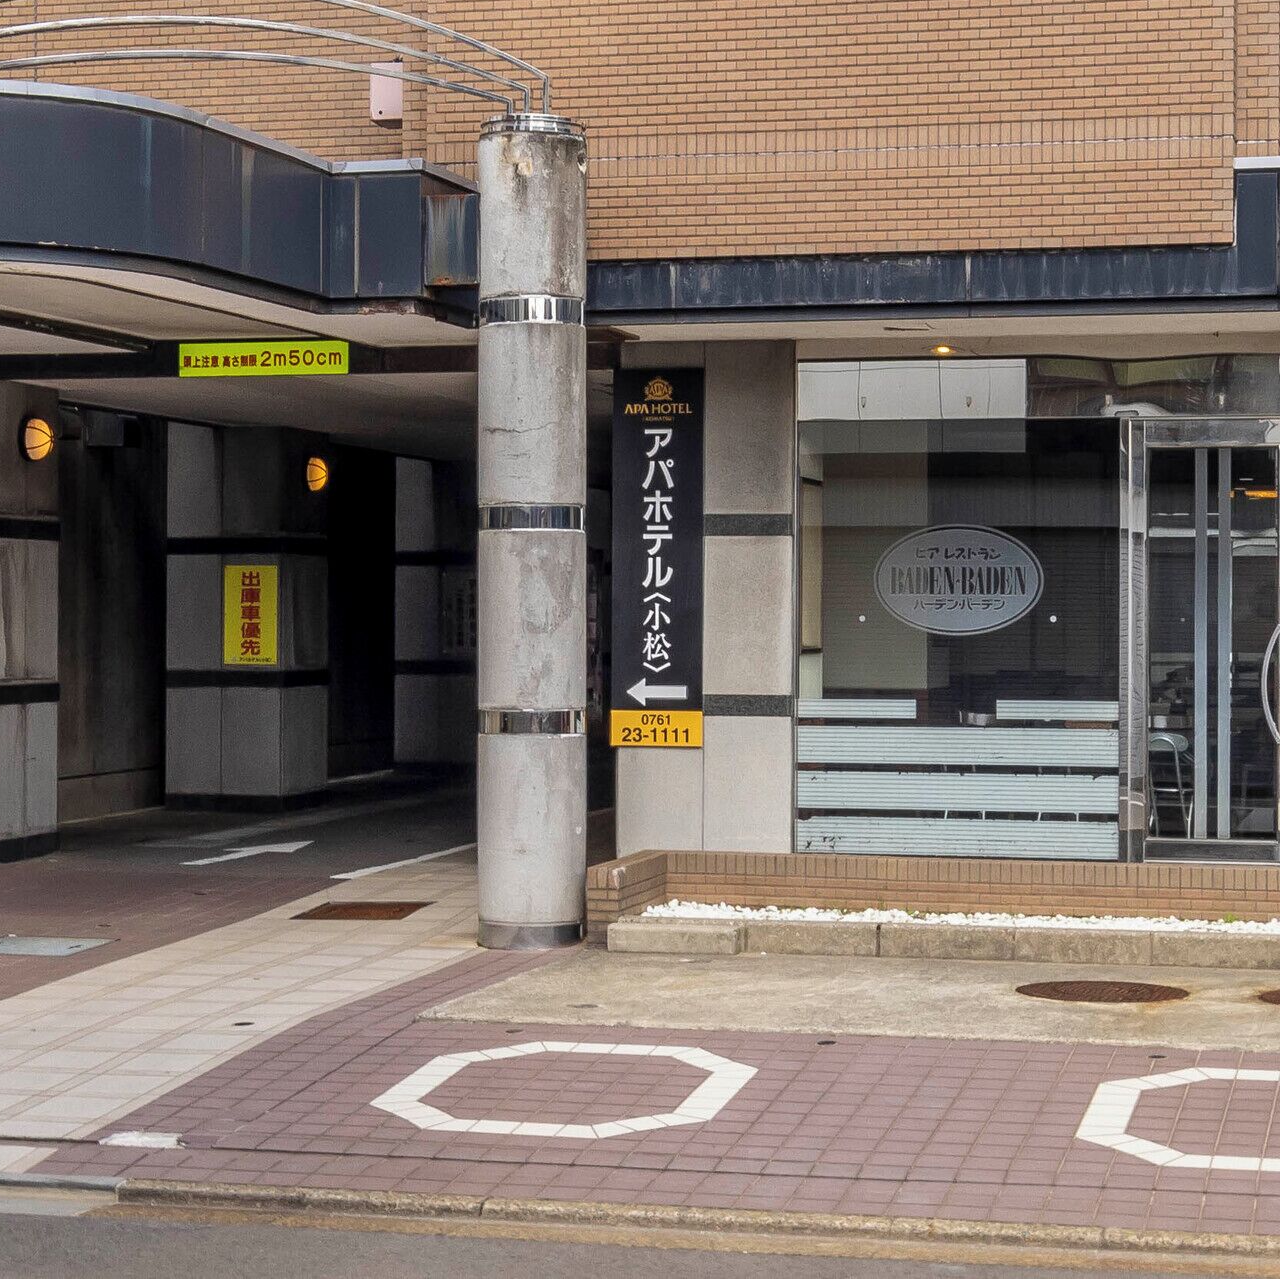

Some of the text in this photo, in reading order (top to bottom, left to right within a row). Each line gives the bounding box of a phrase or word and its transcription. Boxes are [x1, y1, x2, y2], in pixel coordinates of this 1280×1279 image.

[260, 349, 342, 367] 2m50cm
[625, 403, 692, 414] APA HOTEL
[240, 571, 261, 655] 出庫車優先
[641, 714, 671, 725] 0761
[621, 727, 689, 742] 23-1111
